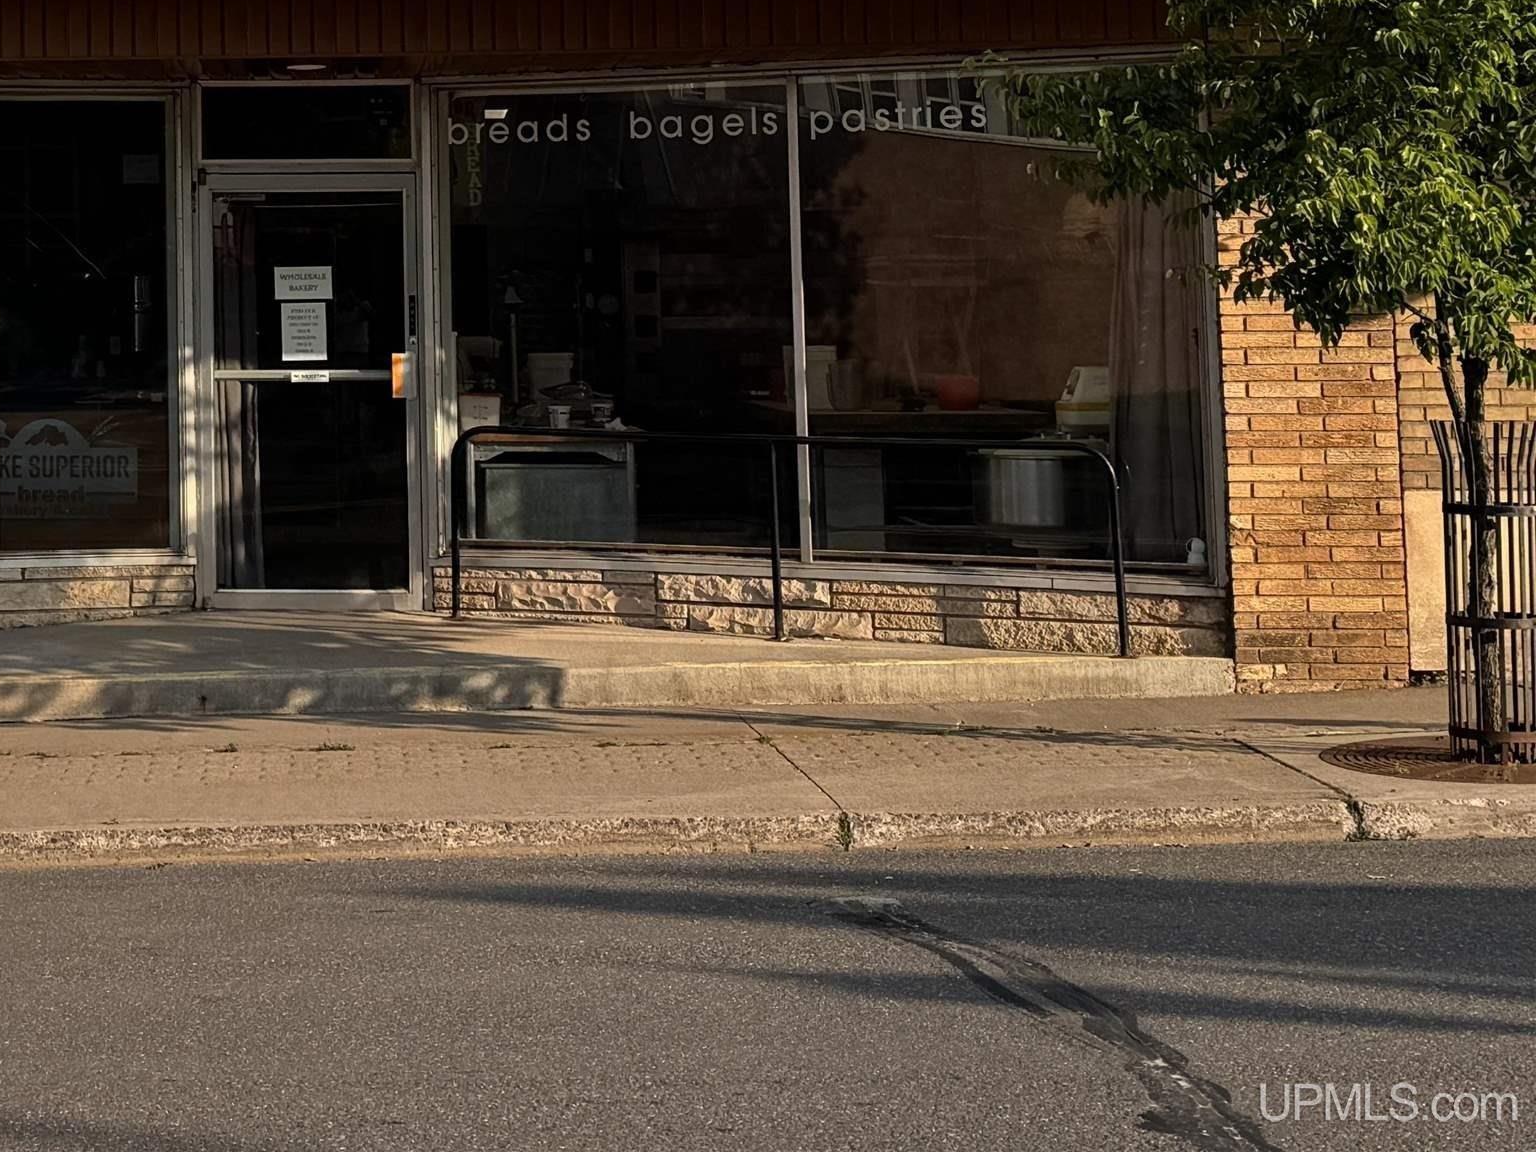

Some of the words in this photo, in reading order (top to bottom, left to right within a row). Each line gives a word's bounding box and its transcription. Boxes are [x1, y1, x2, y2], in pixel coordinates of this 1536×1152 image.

[448, 113, 591, 145] breads
[630, 106, 778, 145] bagels
[810, 100, 987, 141] pastries
[279, 272, 327, 281] WHOLESALE
[288, 284, 320, 292] BAKERY
[28, 454, 130, 479] SUPERIOR
[16, 485, 85, 504] bread
